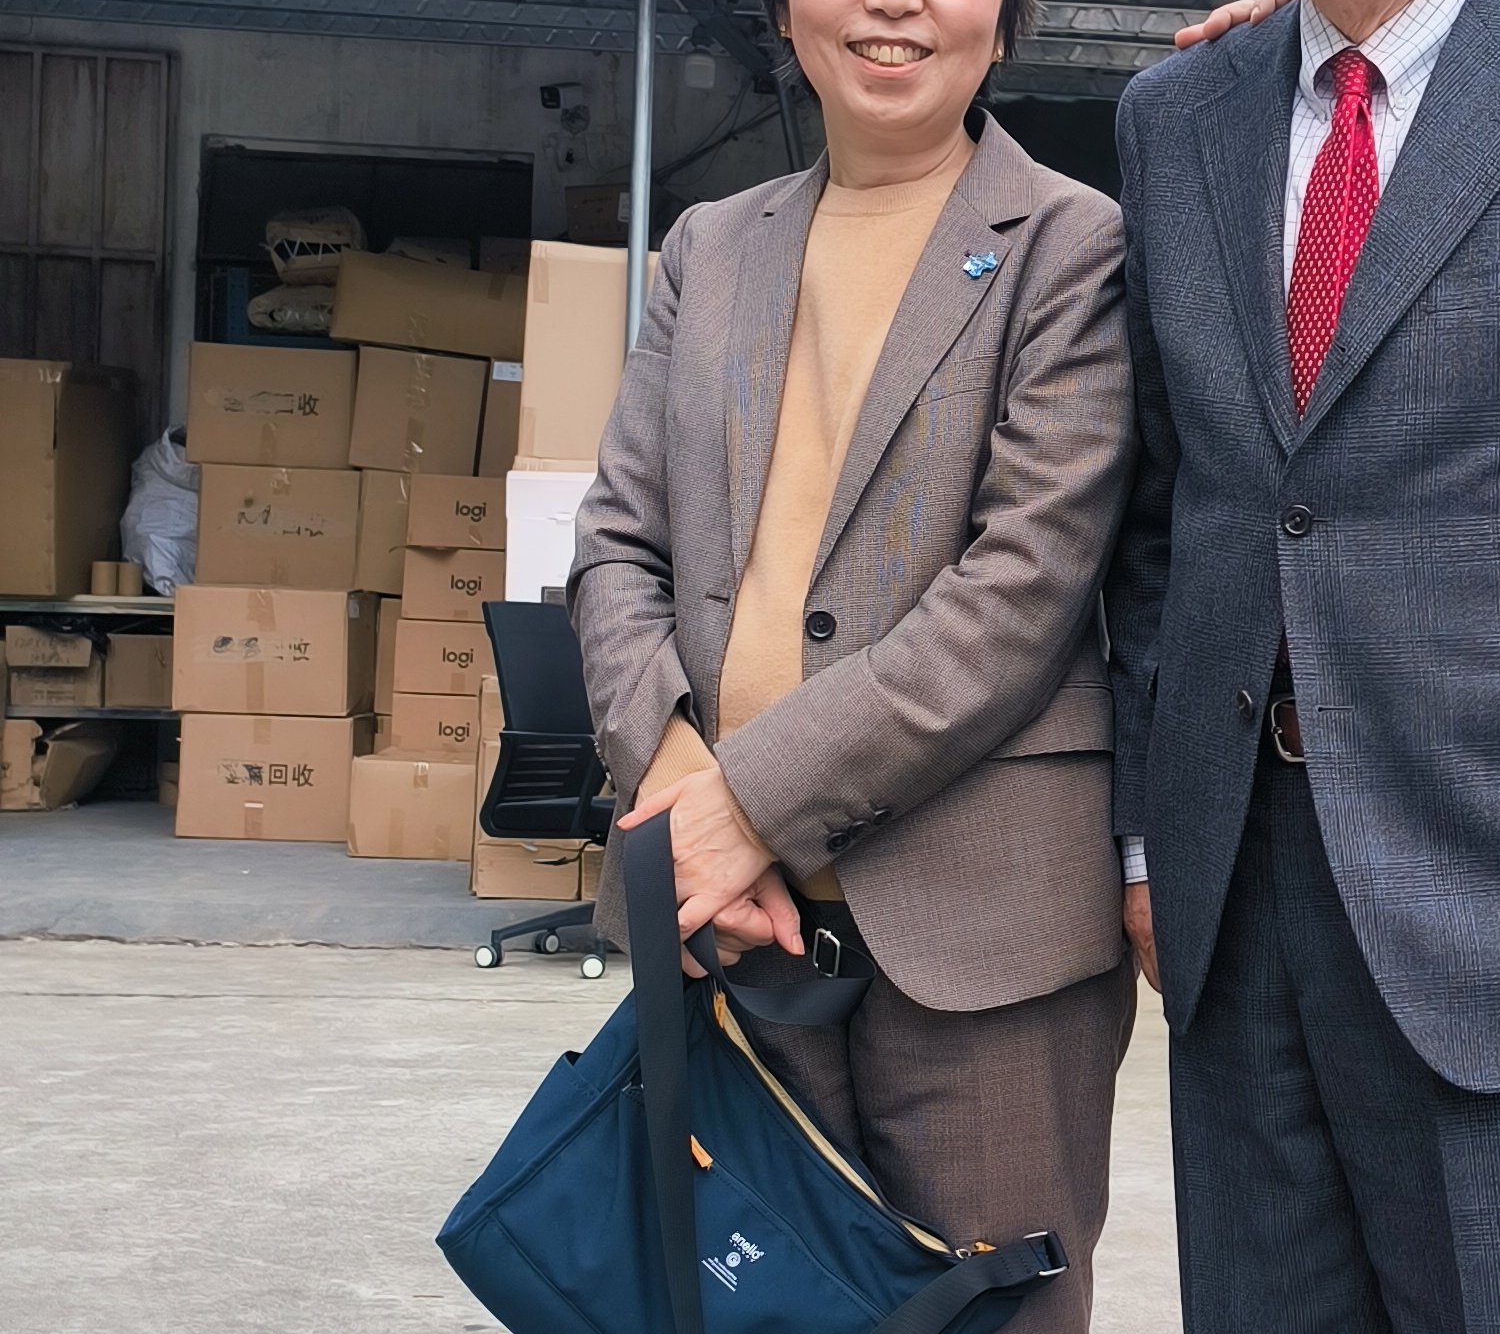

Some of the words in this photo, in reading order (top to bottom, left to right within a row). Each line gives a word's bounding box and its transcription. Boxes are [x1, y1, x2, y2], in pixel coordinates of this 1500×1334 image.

[455, 500, 487, 522] logi
[450, 574, 482, 596] logi
[442, 647, 474, 668] logi
[438, 721, 470, 742] logi
[731, 1232, 760, 1260] anello
